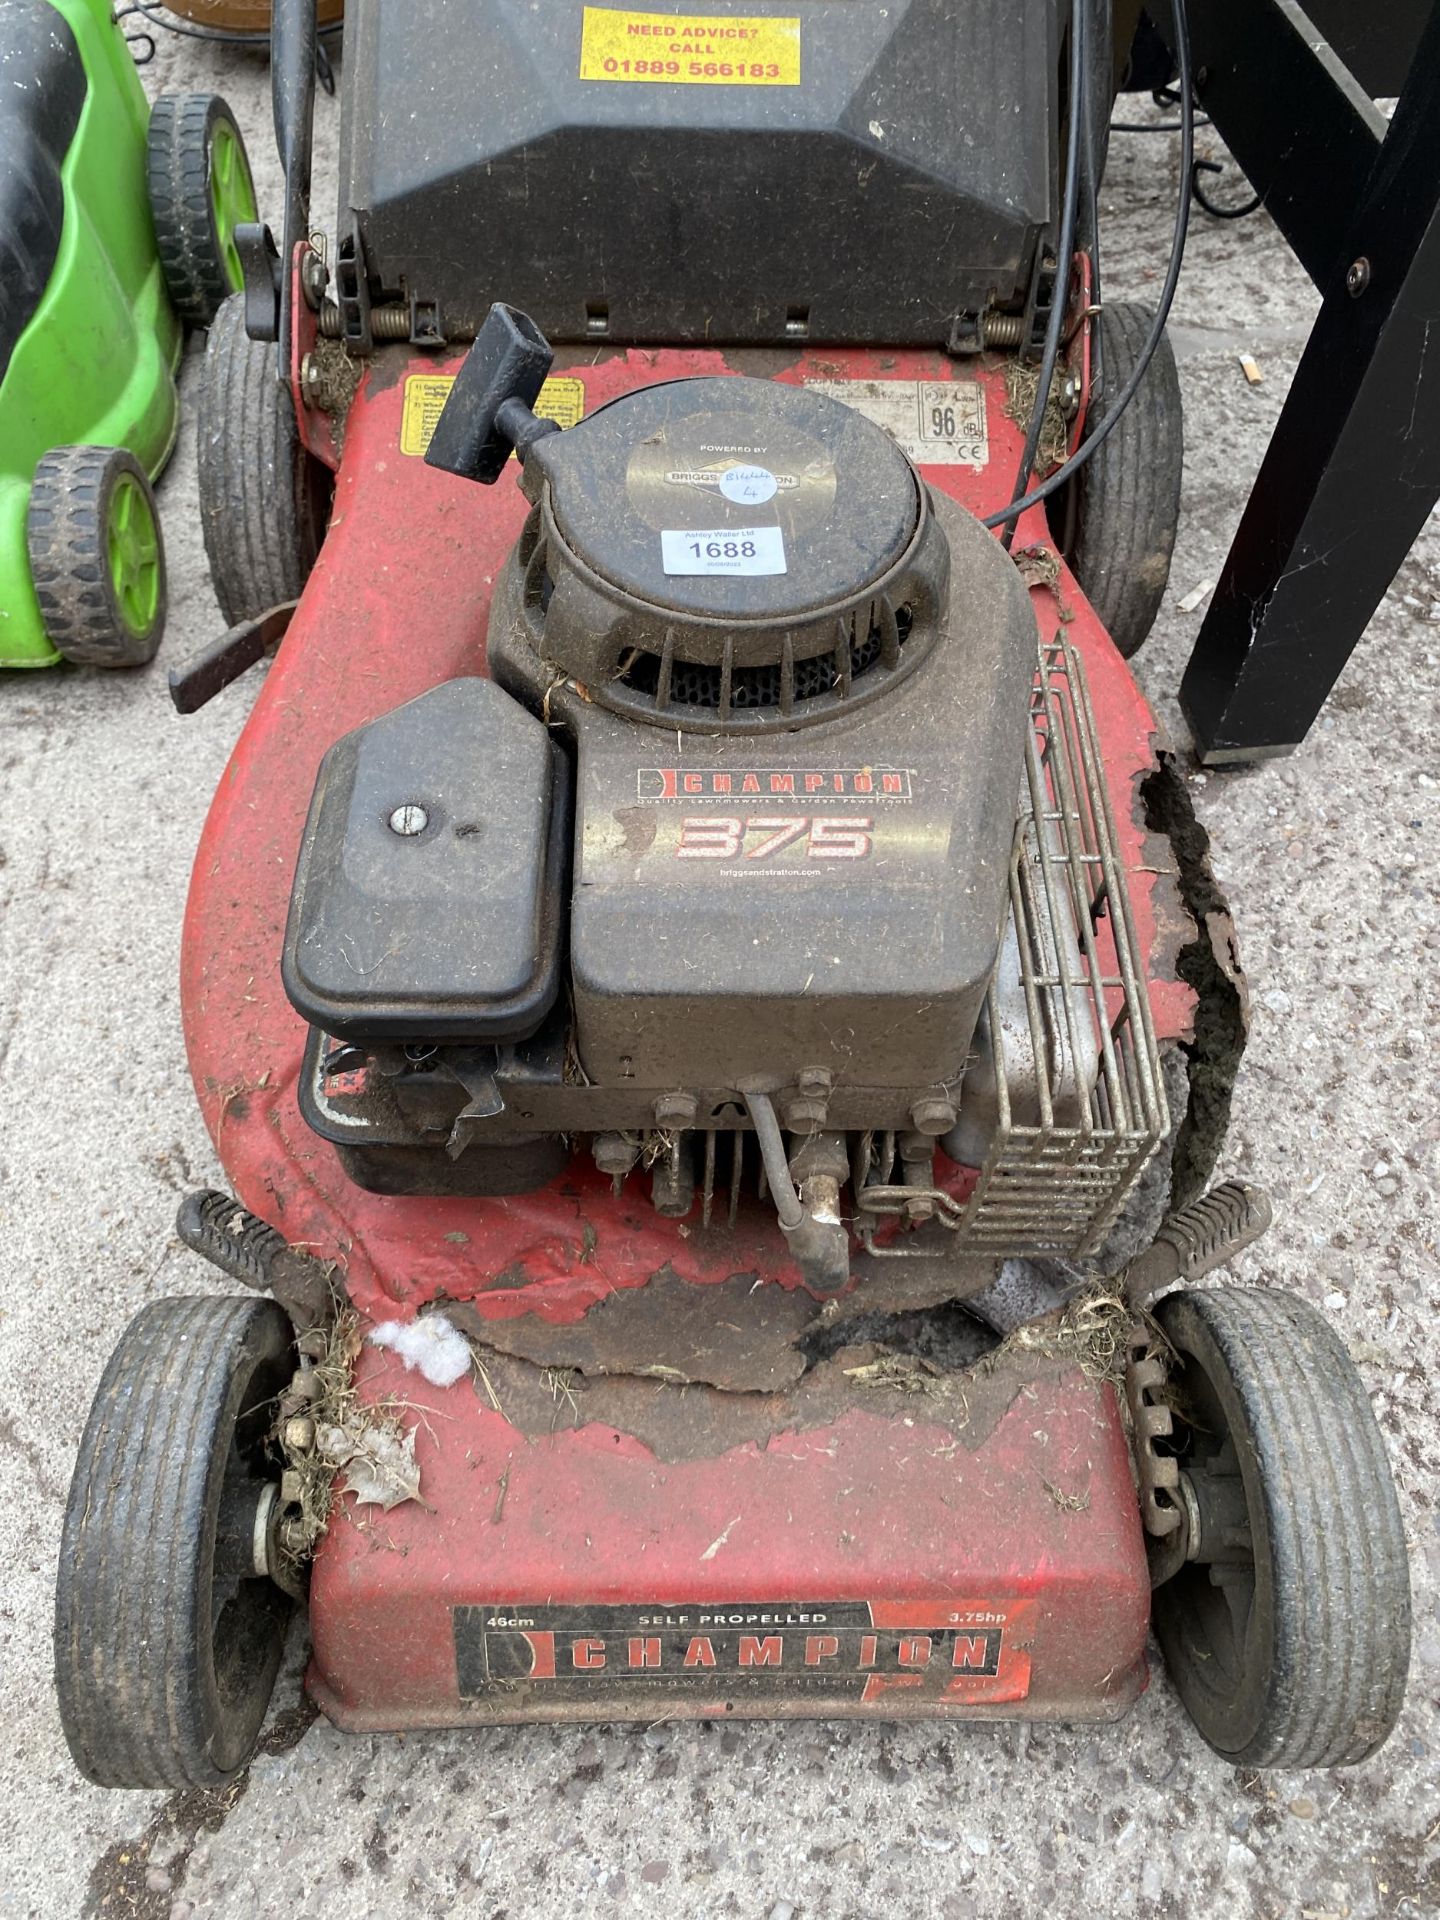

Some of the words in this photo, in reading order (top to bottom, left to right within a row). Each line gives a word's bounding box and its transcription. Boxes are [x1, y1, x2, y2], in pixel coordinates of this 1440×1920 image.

[627, 24, 676, 37] NEED
[681, 27, 759, 39] ADVICE?
[669, 43, 715, 54] CALL
[603, 59, 680, 75] 01889
[688, 62, 780, 78] 566183
[932, 407, 955, 437] 96
[700, 445, 751, 453] POWERED
[753, 446, 768, 454] BY
[958, 445, 982, 460] CE
[671, 473, 717, 482] BRIGGS
[689, 541, 757, 559] 1688
[683, 773, 903, 793] CHAMPION
[675, 816, 875, 861] 375
[719, 868, 822, 877] briggsandstratton.com
[486, 1616, 535, 1628] 46cm
[638, 1615, 690, 1625] SELF
[700, 1613, 828, 1625] PROPELLED
[948, 1611, 1008, 1624] 3.75hp
[572, 1635, 988, 1669] CHAMPION
